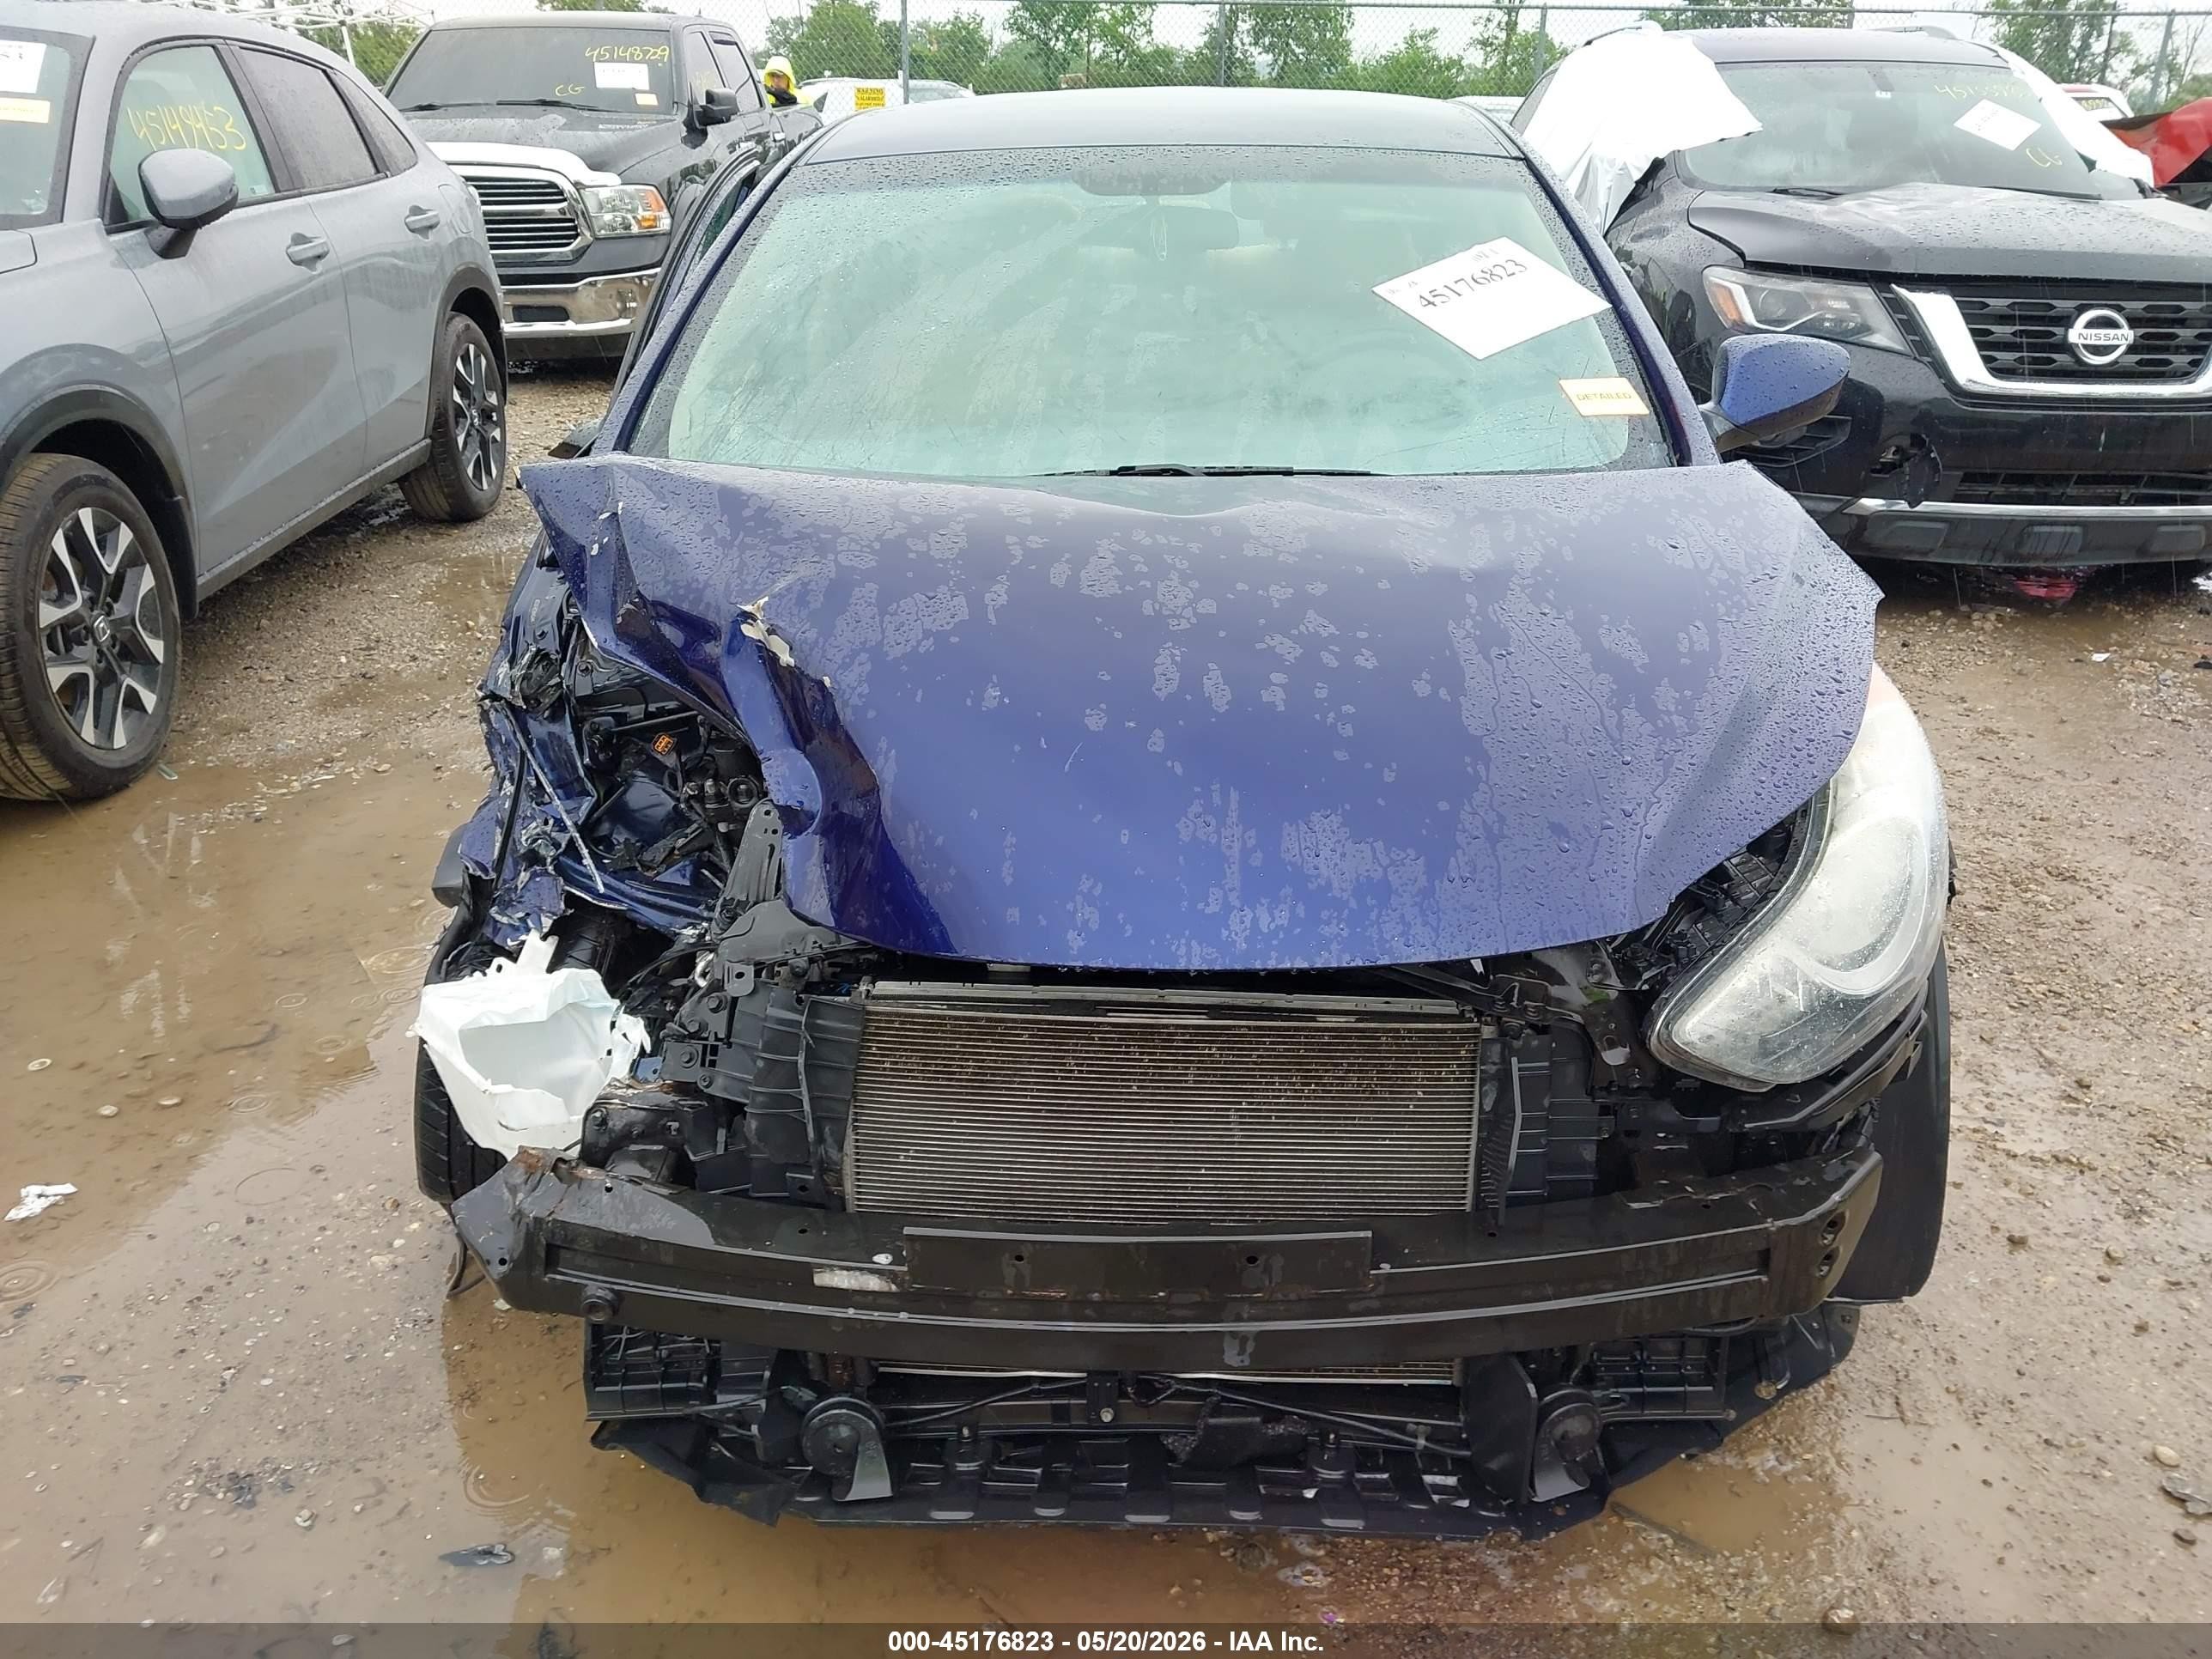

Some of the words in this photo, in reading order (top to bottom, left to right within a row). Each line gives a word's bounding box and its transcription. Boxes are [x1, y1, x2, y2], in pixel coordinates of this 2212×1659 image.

[555, 83, 585, 97] CG
[1419, 258, 1528, 307] 45176823
[2078, 332, 2129, 342] NISSAN
[1577, 392, 1632, 401] DETAILED
